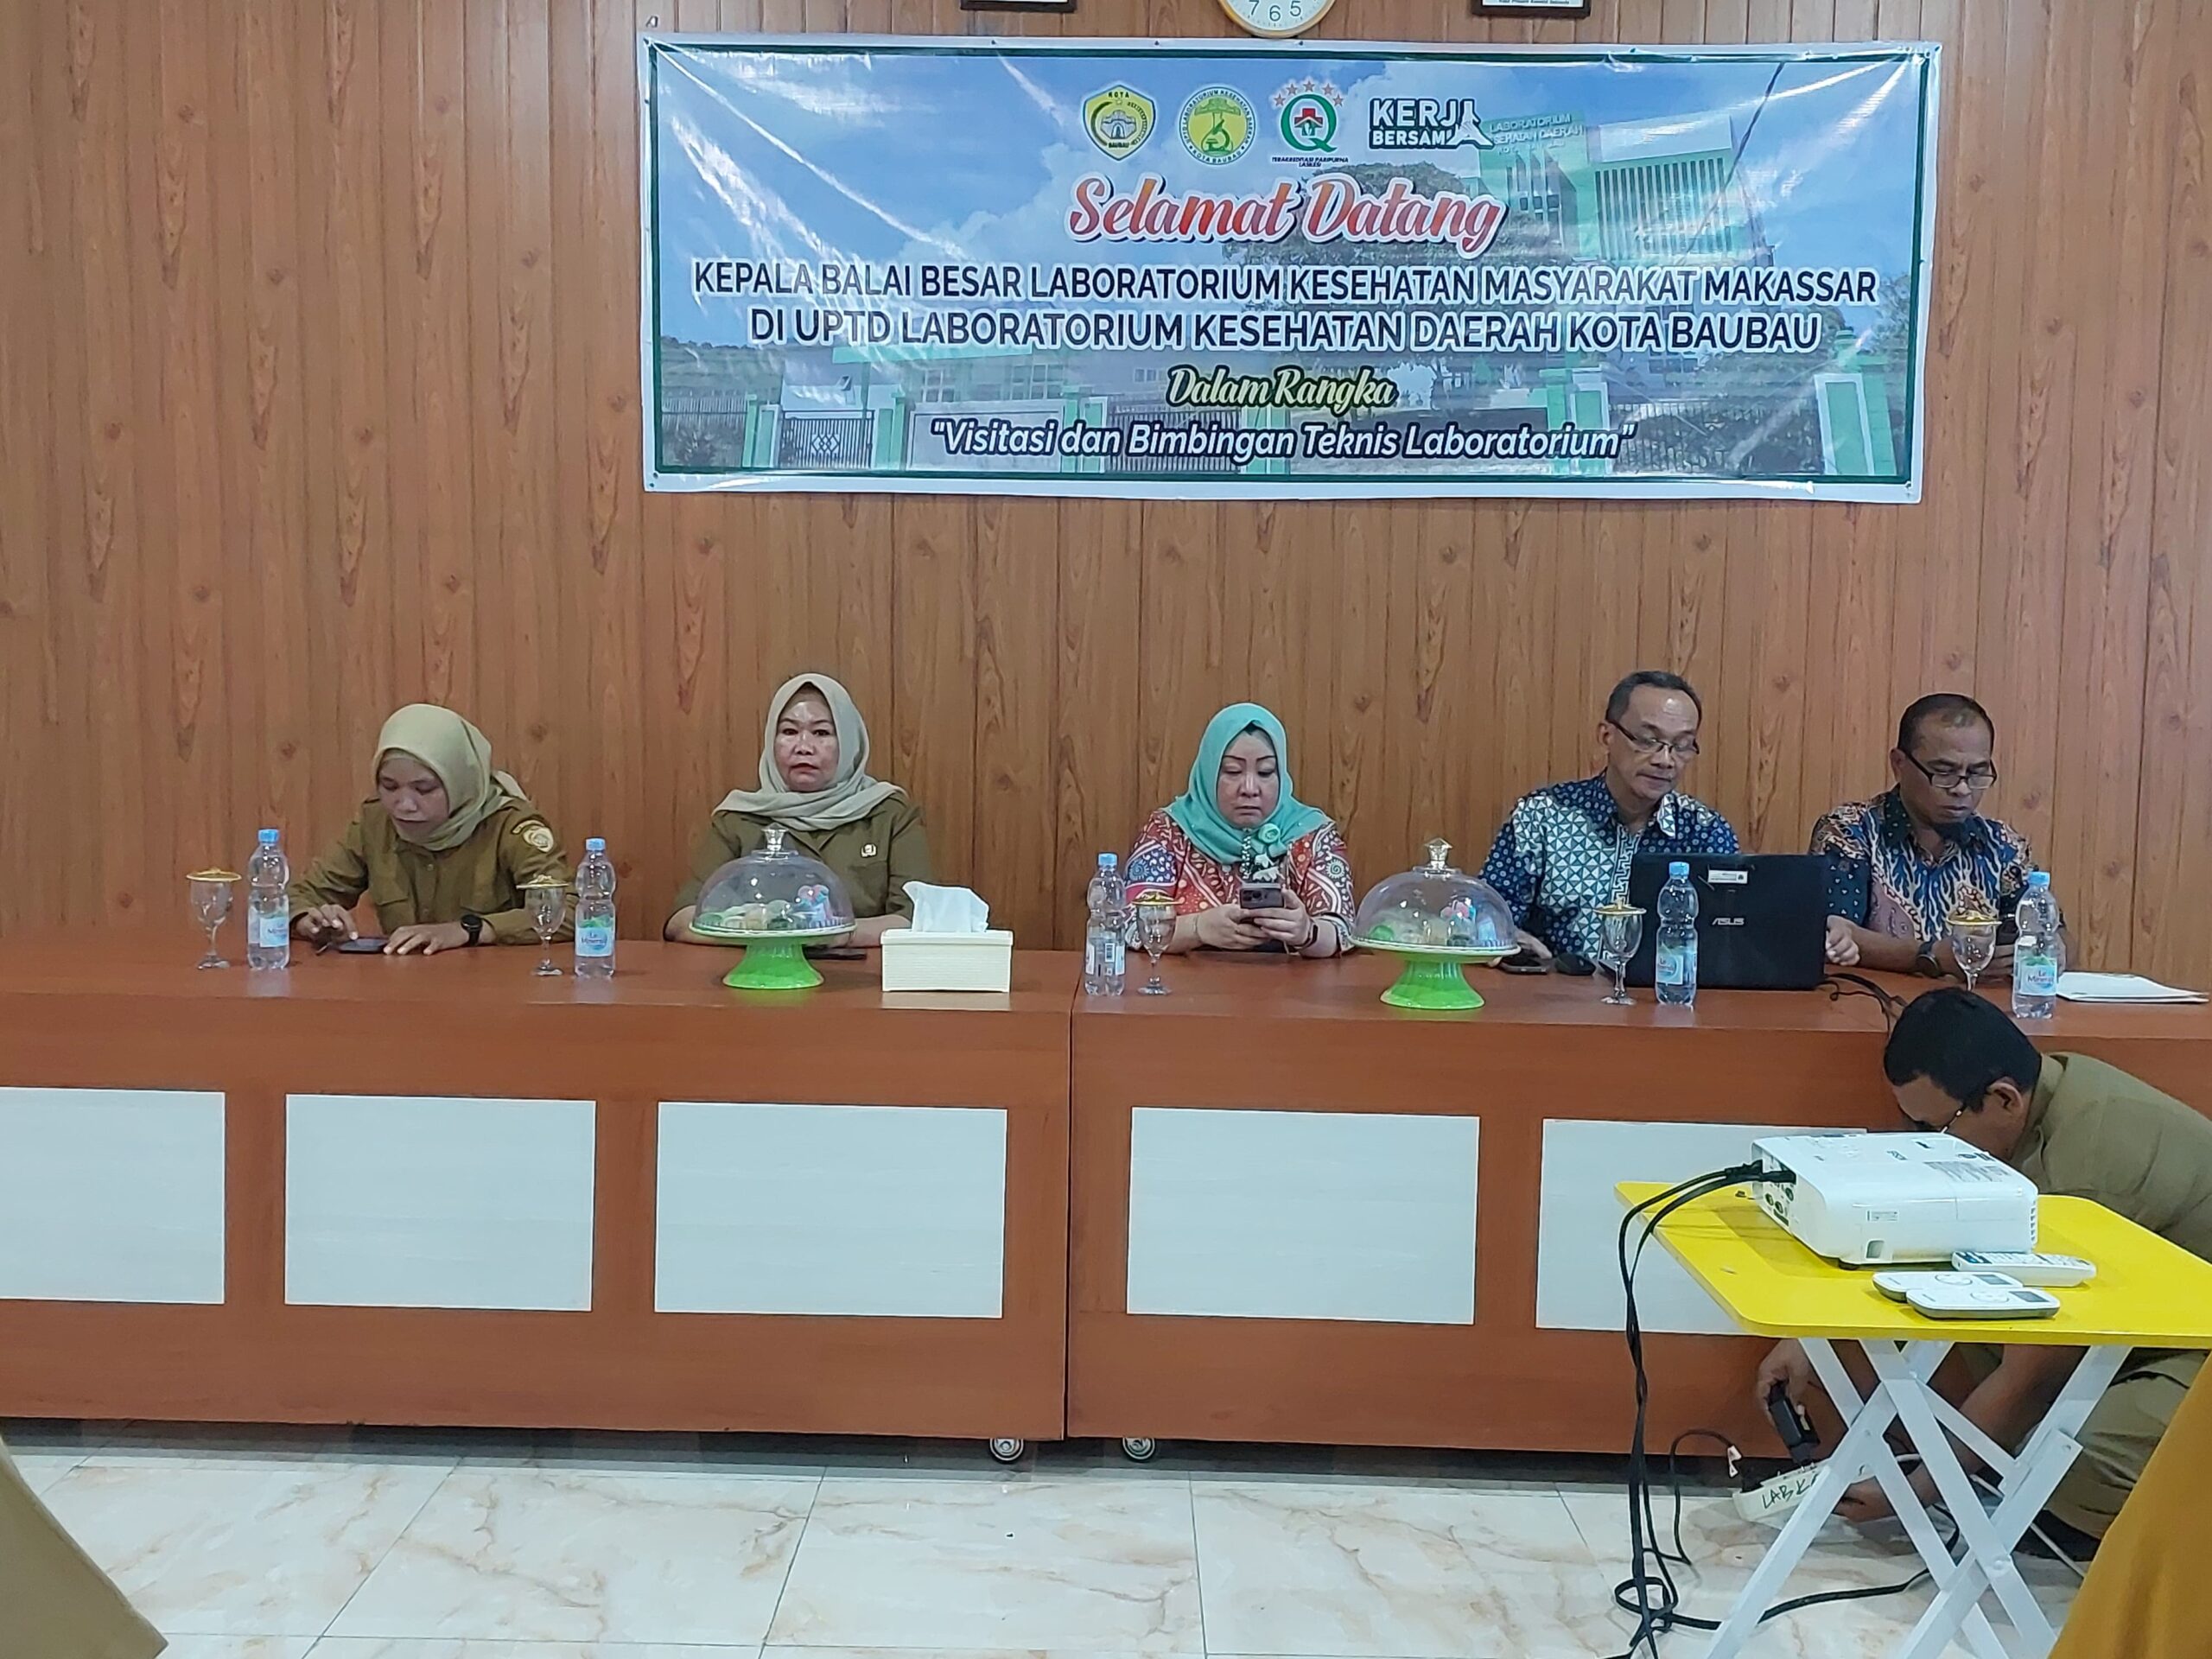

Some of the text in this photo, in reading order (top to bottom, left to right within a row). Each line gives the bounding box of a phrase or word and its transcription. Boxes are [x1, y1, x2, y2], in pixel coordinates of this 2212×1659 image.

[1249, 0, 1301, 22] 7 6 5
[1069, 175, 1505, 254] Selamat Datang
[695, 261, 1877, 302] KEPALA BALAI BESAR LABORATORIUM KESEHATAN MASYARAKAT MAKASSAR
[751, 308, 1818, 349] DI UPTD LABORATORIUM KESEHATAN DAERAH KOTA BAUBAU
[1169, 367, 1395, 413] Dalam Rangka
[1061, 421, 1120, 454] dan
[1128, 423, 1294, 462] Bimbingan
[1304, 423, 1399, 456] Teknis
[1711, 917, 1745, 926] ASUS
